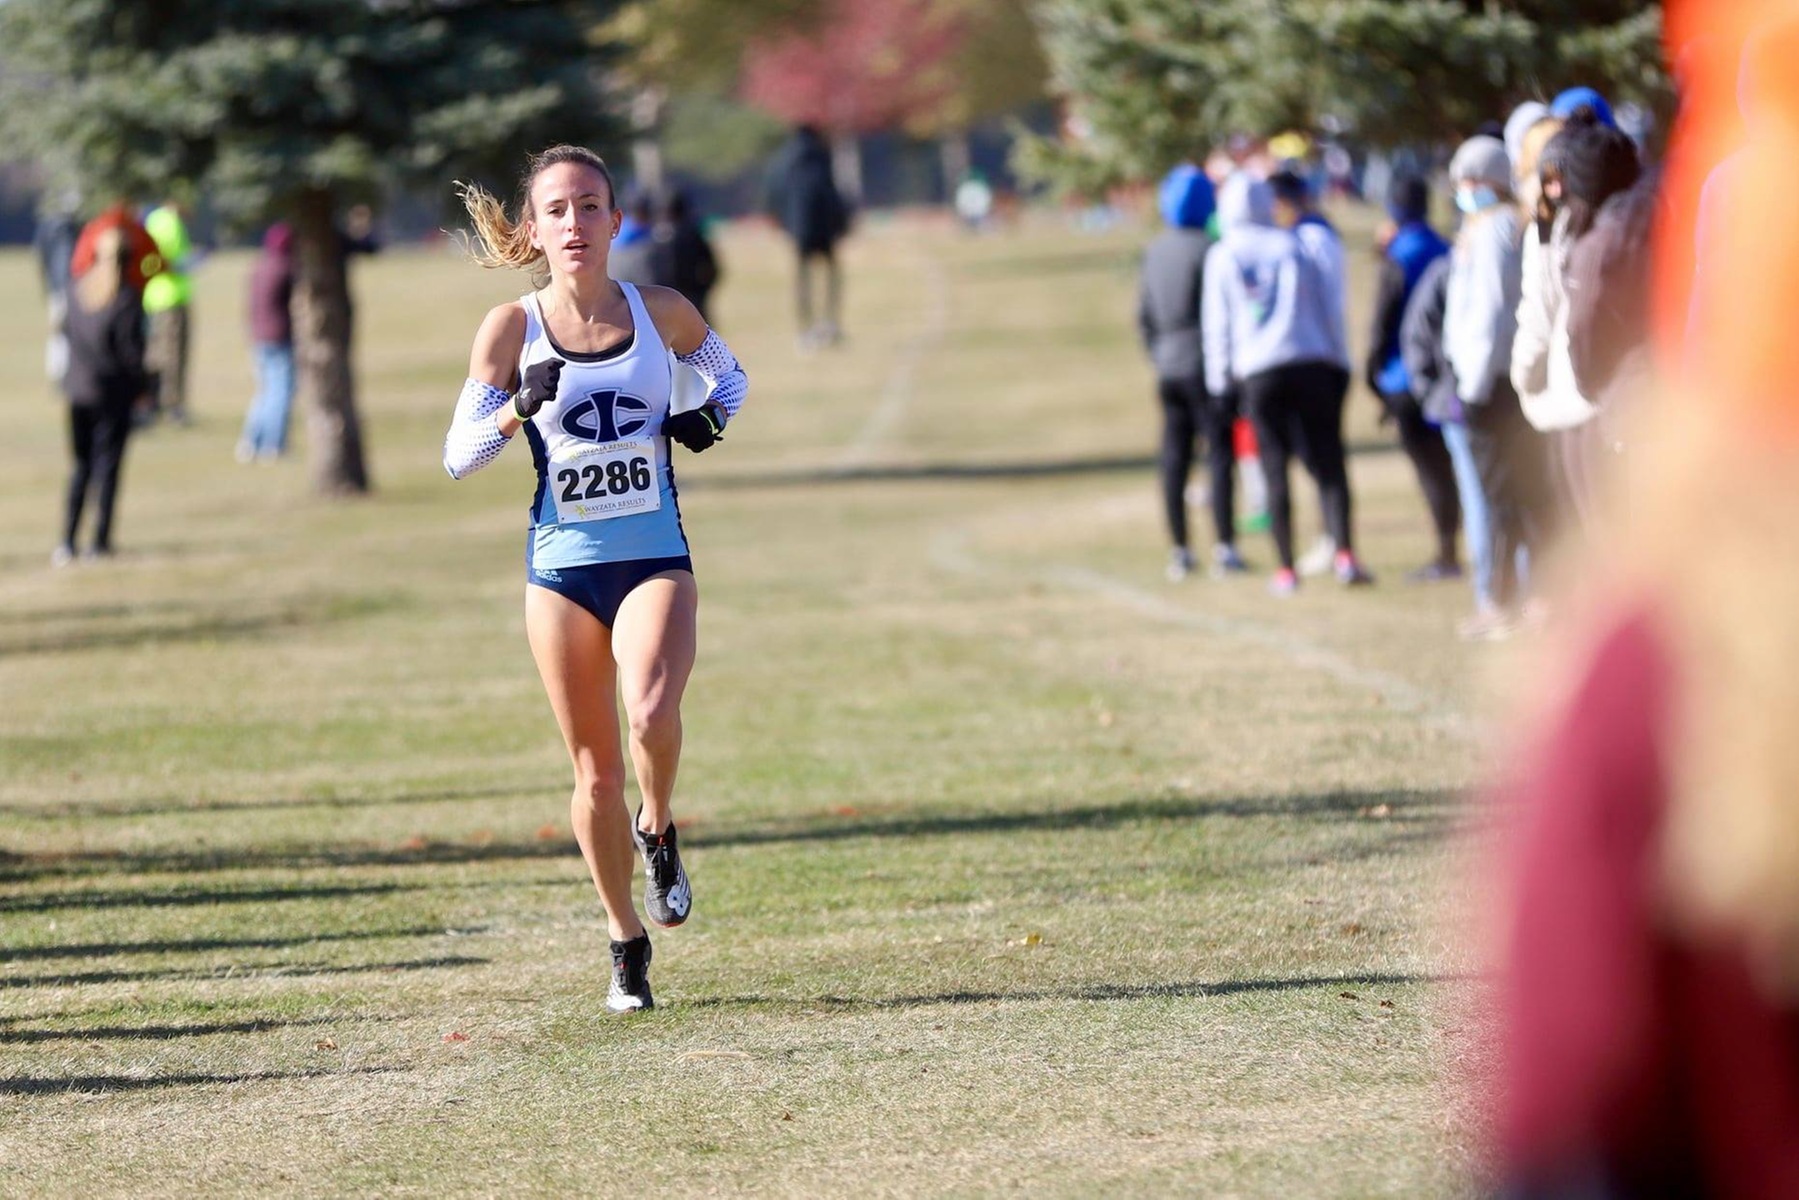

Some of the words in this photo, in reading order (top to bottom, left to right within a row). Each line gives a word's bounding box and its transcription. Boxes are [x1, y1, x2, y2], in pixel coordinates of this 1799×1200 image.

[557, 457, 651, 502] 2286
[585, 502, 617, 512] WAYZATA
[618, 498, 646, 507] RESULTS
